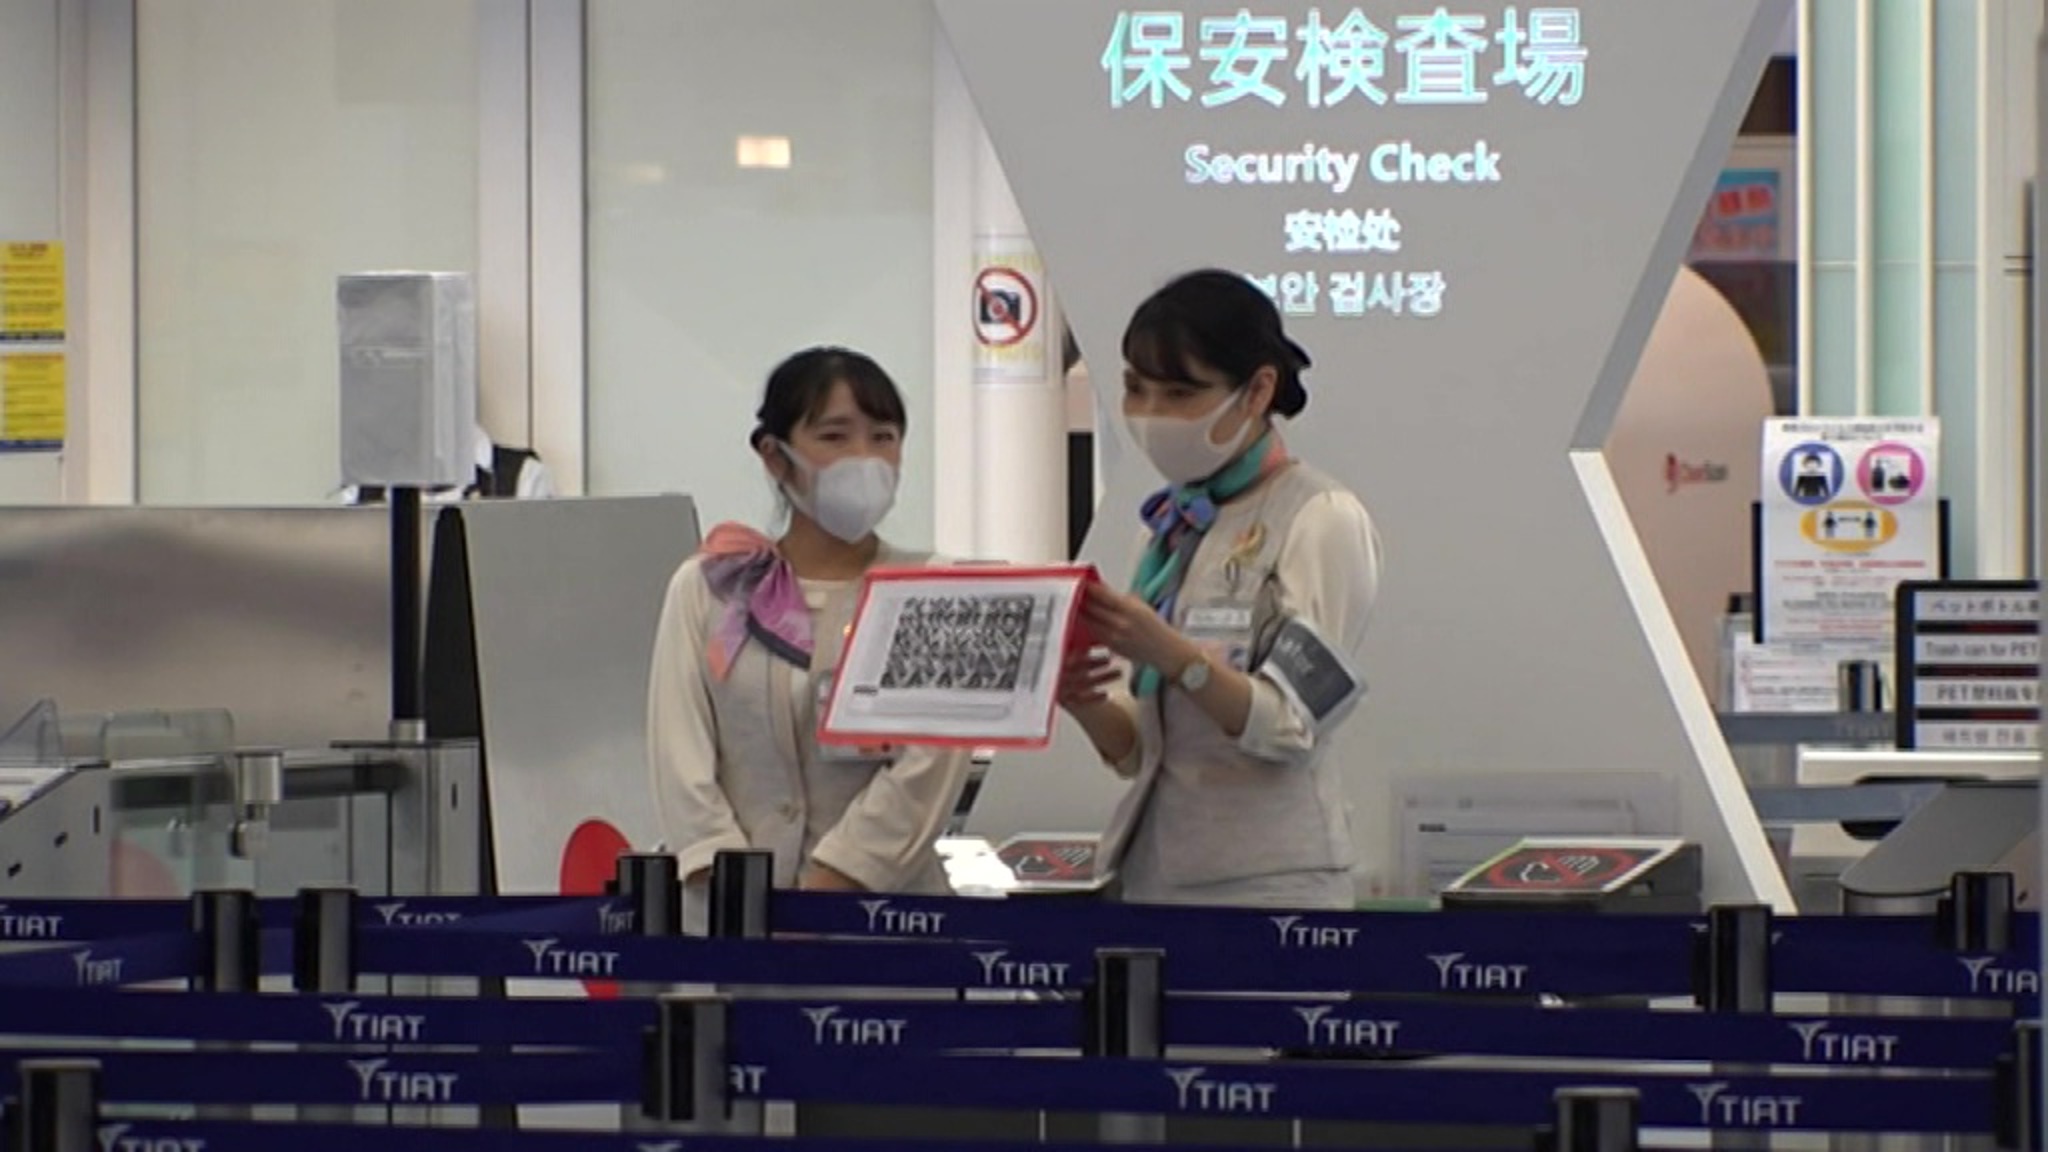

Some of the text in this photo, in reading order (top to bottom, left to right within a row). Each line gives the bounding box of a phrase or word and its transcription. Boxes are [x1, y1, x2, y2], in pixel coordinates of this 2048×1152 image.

[1101, 7, 1588, 109] 保安検査場
[1185, 141, 1501, 192] Security Check
[1284, 209, 1400, 251] 安检处
[1328, 271, 1446, 316] 검사장
